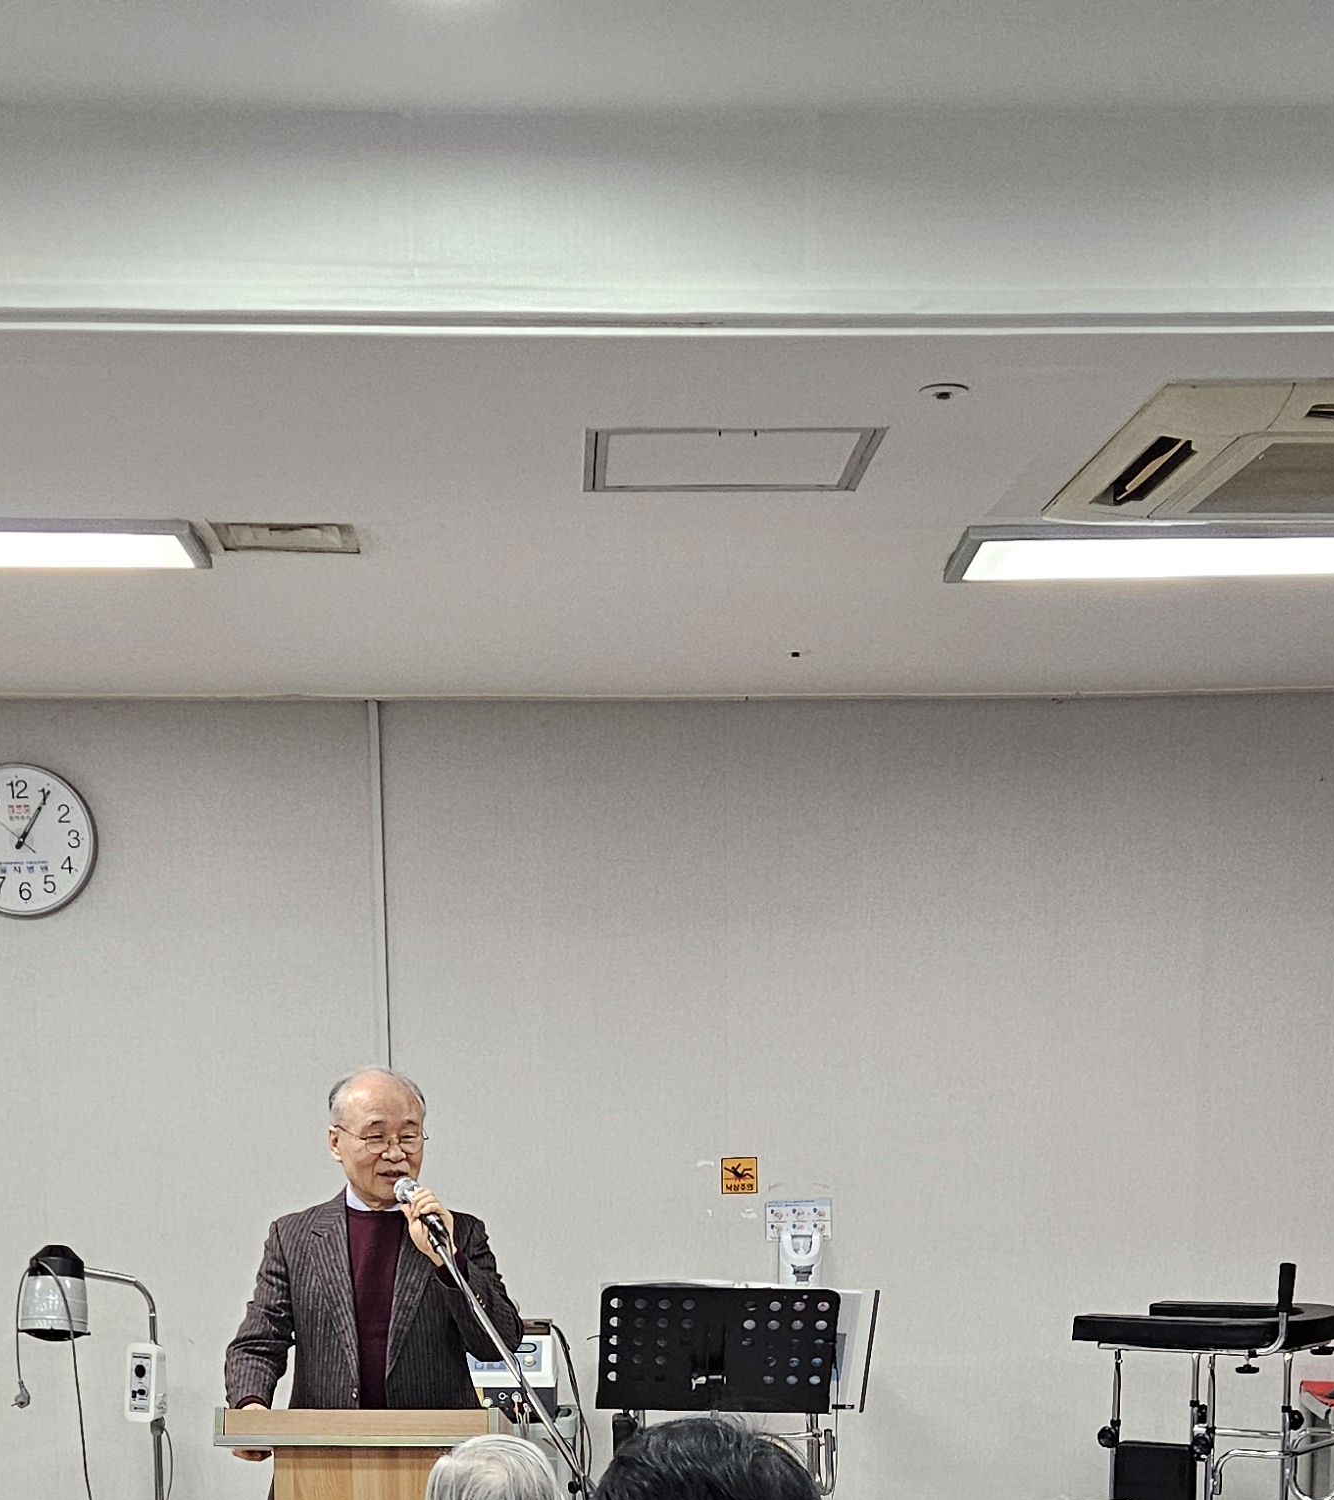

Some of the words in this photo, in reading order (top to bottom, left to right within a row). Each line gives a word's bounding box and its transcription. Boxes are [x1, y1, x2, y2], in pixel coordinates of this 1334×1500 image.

[6, 780, 29, 799] 12
[38, 787, 46, 805] 1
[57, 804, 71, 823] 2
[67, 829, 81, 848] 3
[60, 856, 74, 874] 4
[18, 881, 32, 901] 6
[43, 874, 56, 894] 5
[726, 1183, 754, 1191] 낙상주의
